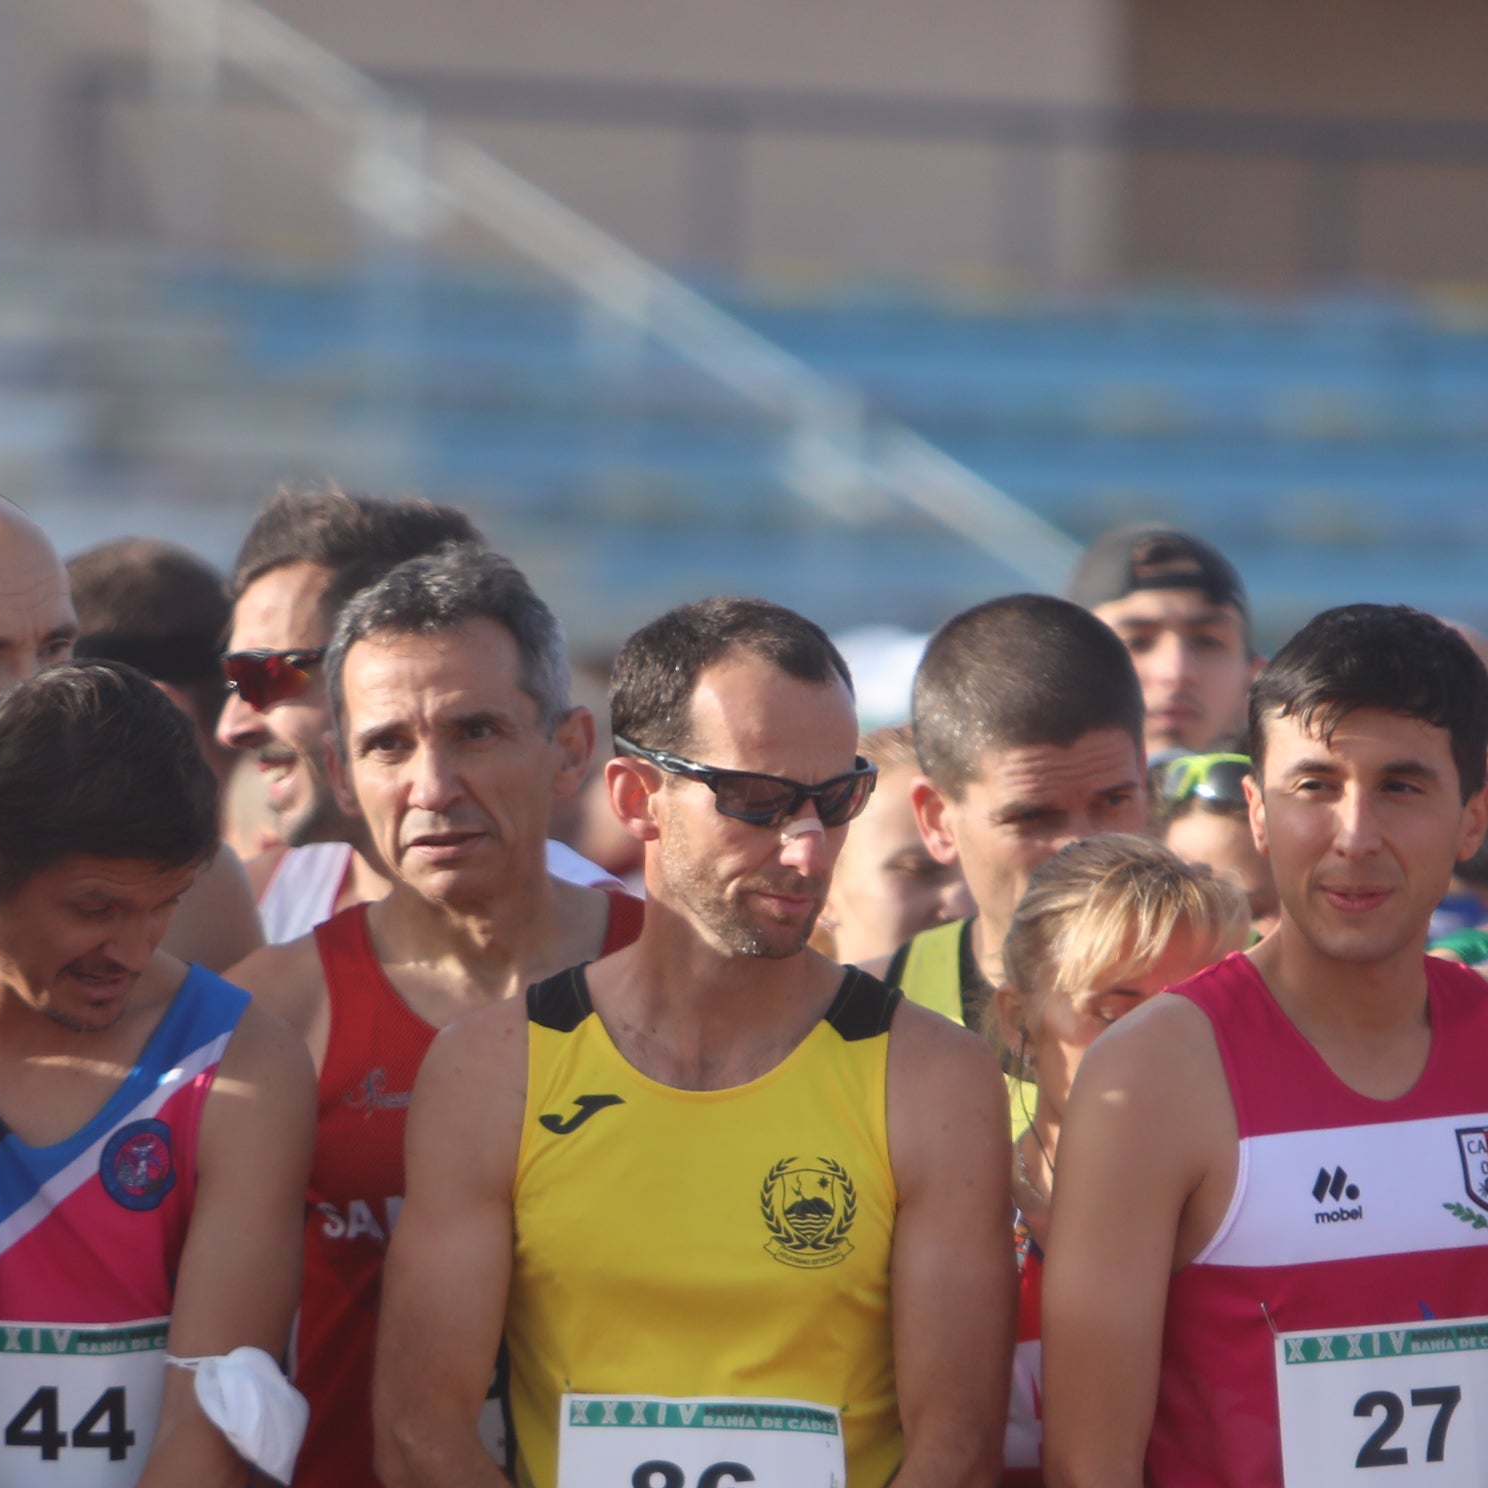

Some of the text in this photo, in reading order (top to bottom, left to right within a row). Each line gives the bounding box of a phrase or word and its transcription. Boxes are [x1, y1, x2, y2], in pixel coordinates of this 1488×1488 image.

[1314, 1205, 1363, 1225] mobel
[4, 1385, 136, 1462] 44
[703, 1415, 837, 1434] BAHÍA DE CÁDIZ
[1352, 1384, 1462, 1469] 27
